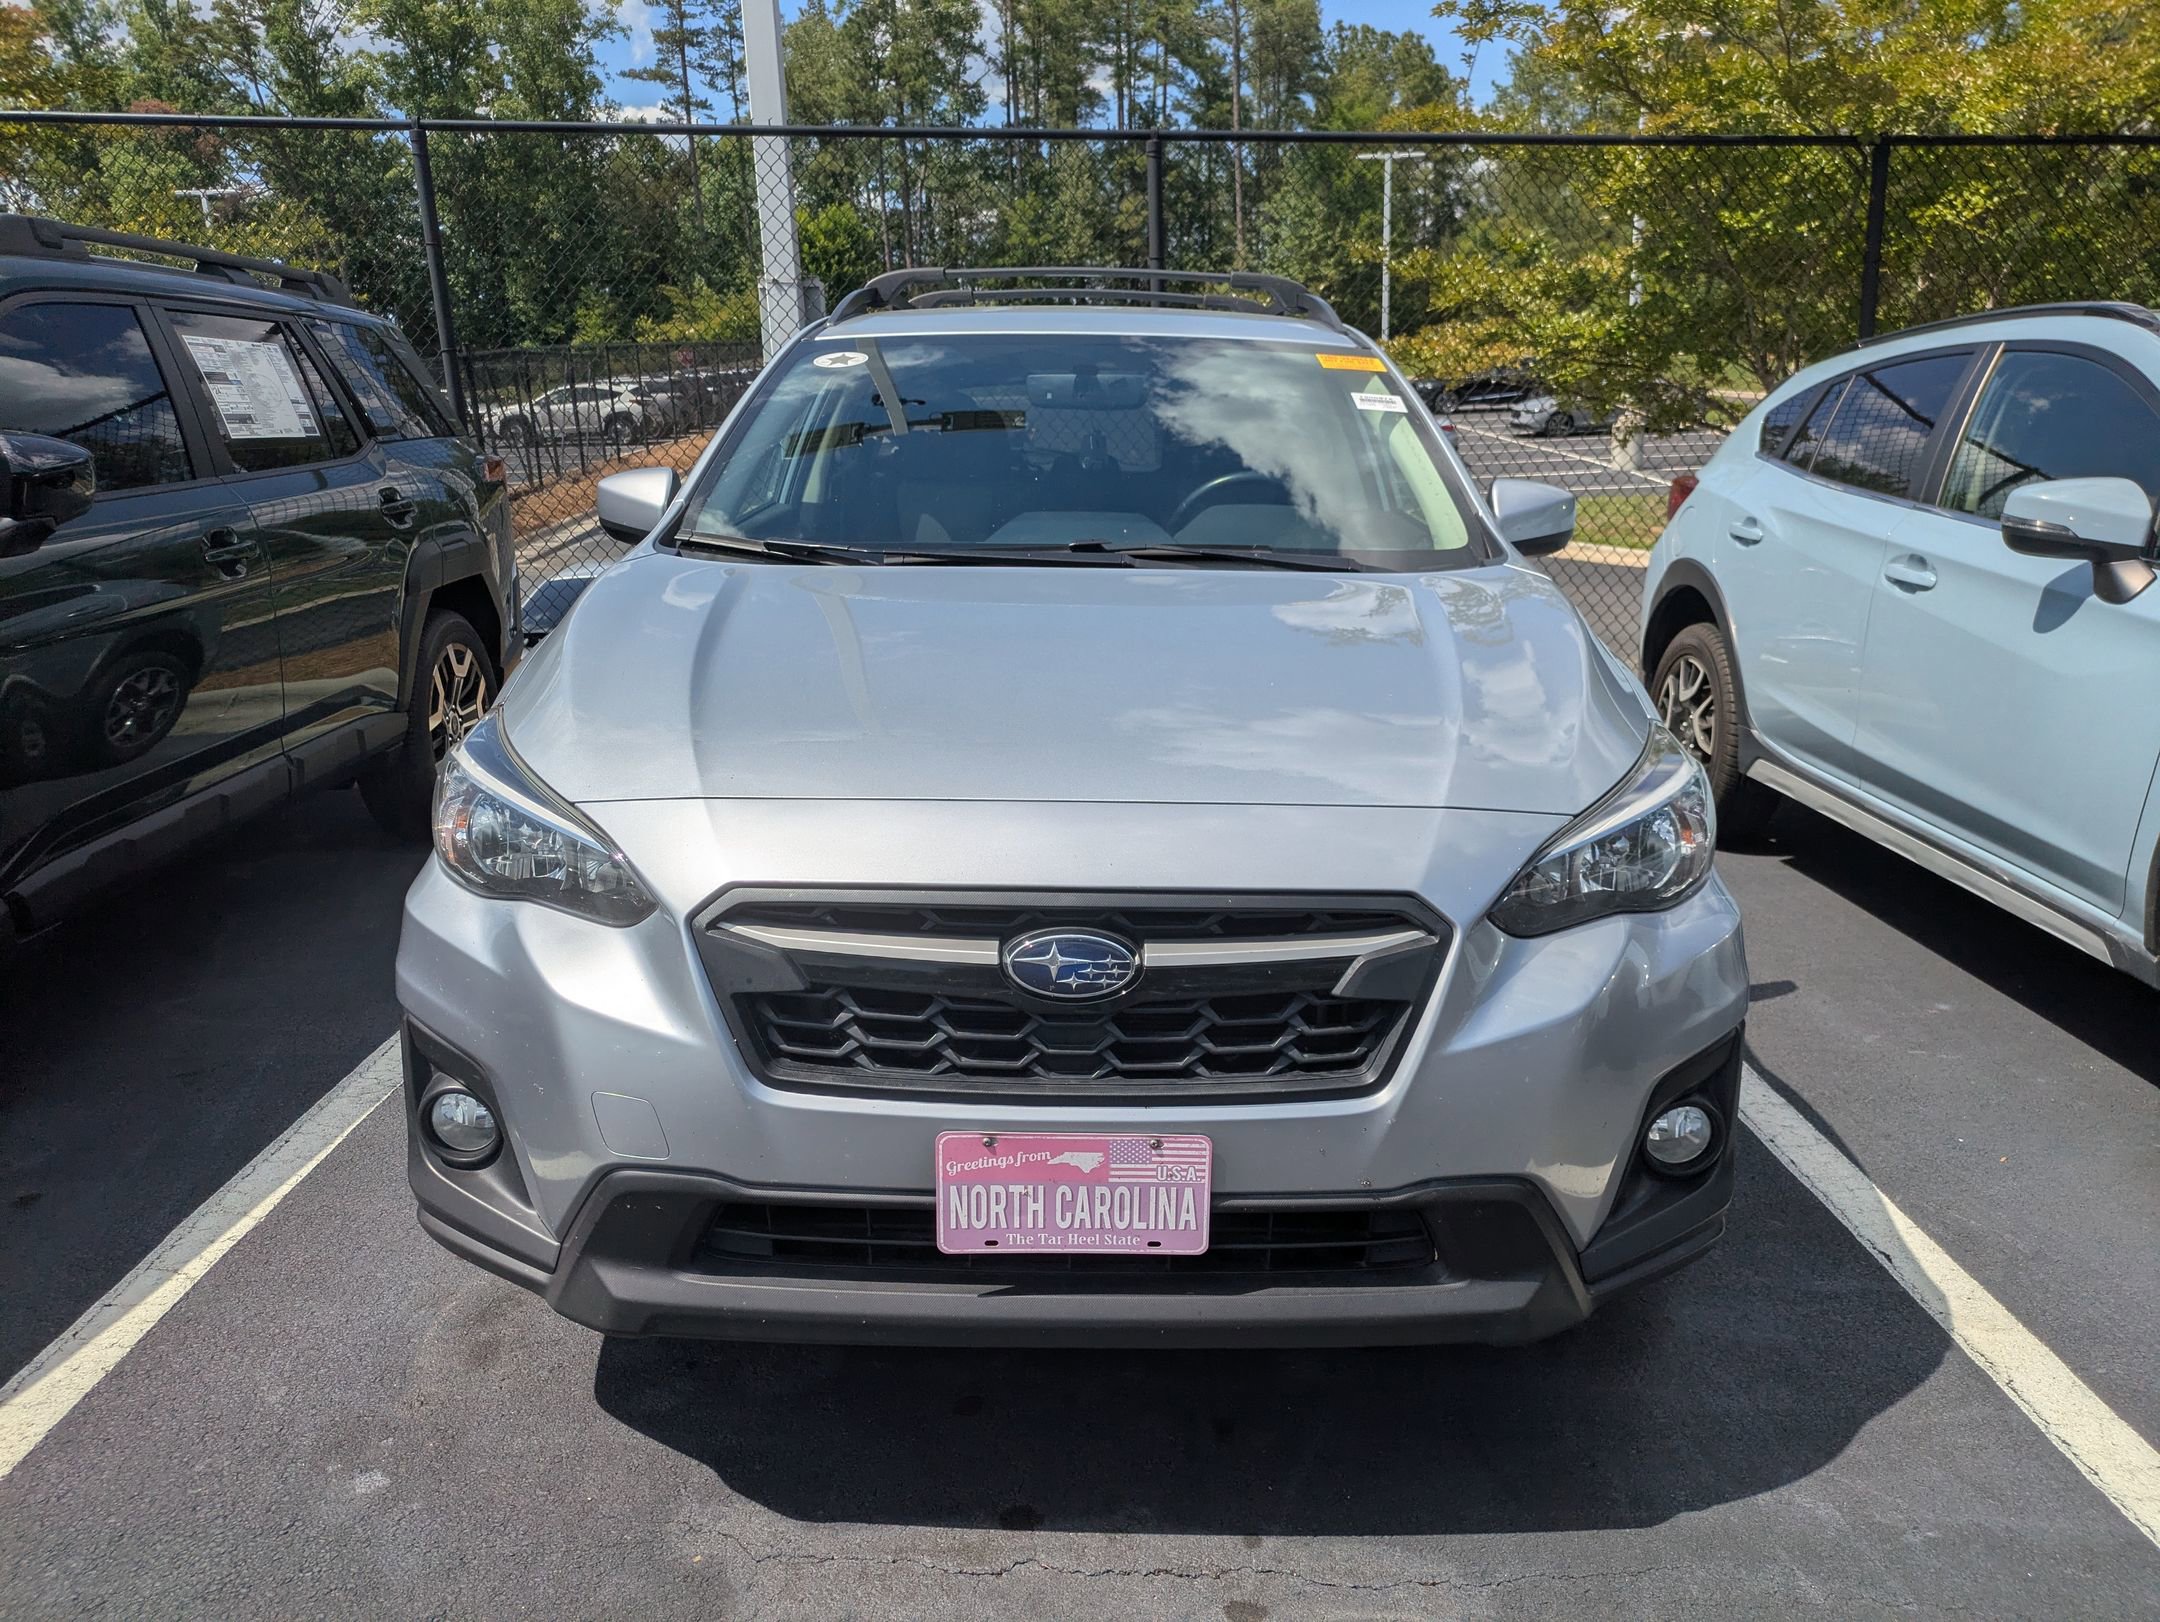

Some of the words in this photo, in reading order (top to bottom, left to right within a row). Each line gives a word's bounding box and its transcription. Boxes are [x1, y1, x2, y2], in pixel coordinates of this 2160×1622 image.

[946, 1155, 1014, 1176] Greetings
[1014, 1151, 1052, 1166] from
[1157, 1165, 1202, 1181] U.S.A.
[949, 1184, 1045, 1229] NORTH
[1055, 1185, 1197, 1231] CAROLINA
[1006, 1233, 1034, 1245] The
[1038, 1233, 1065, 1245] Tar
[1068, 1233, 1100, 1245] Heel
[1104, 1233, 1141, 1246] State
